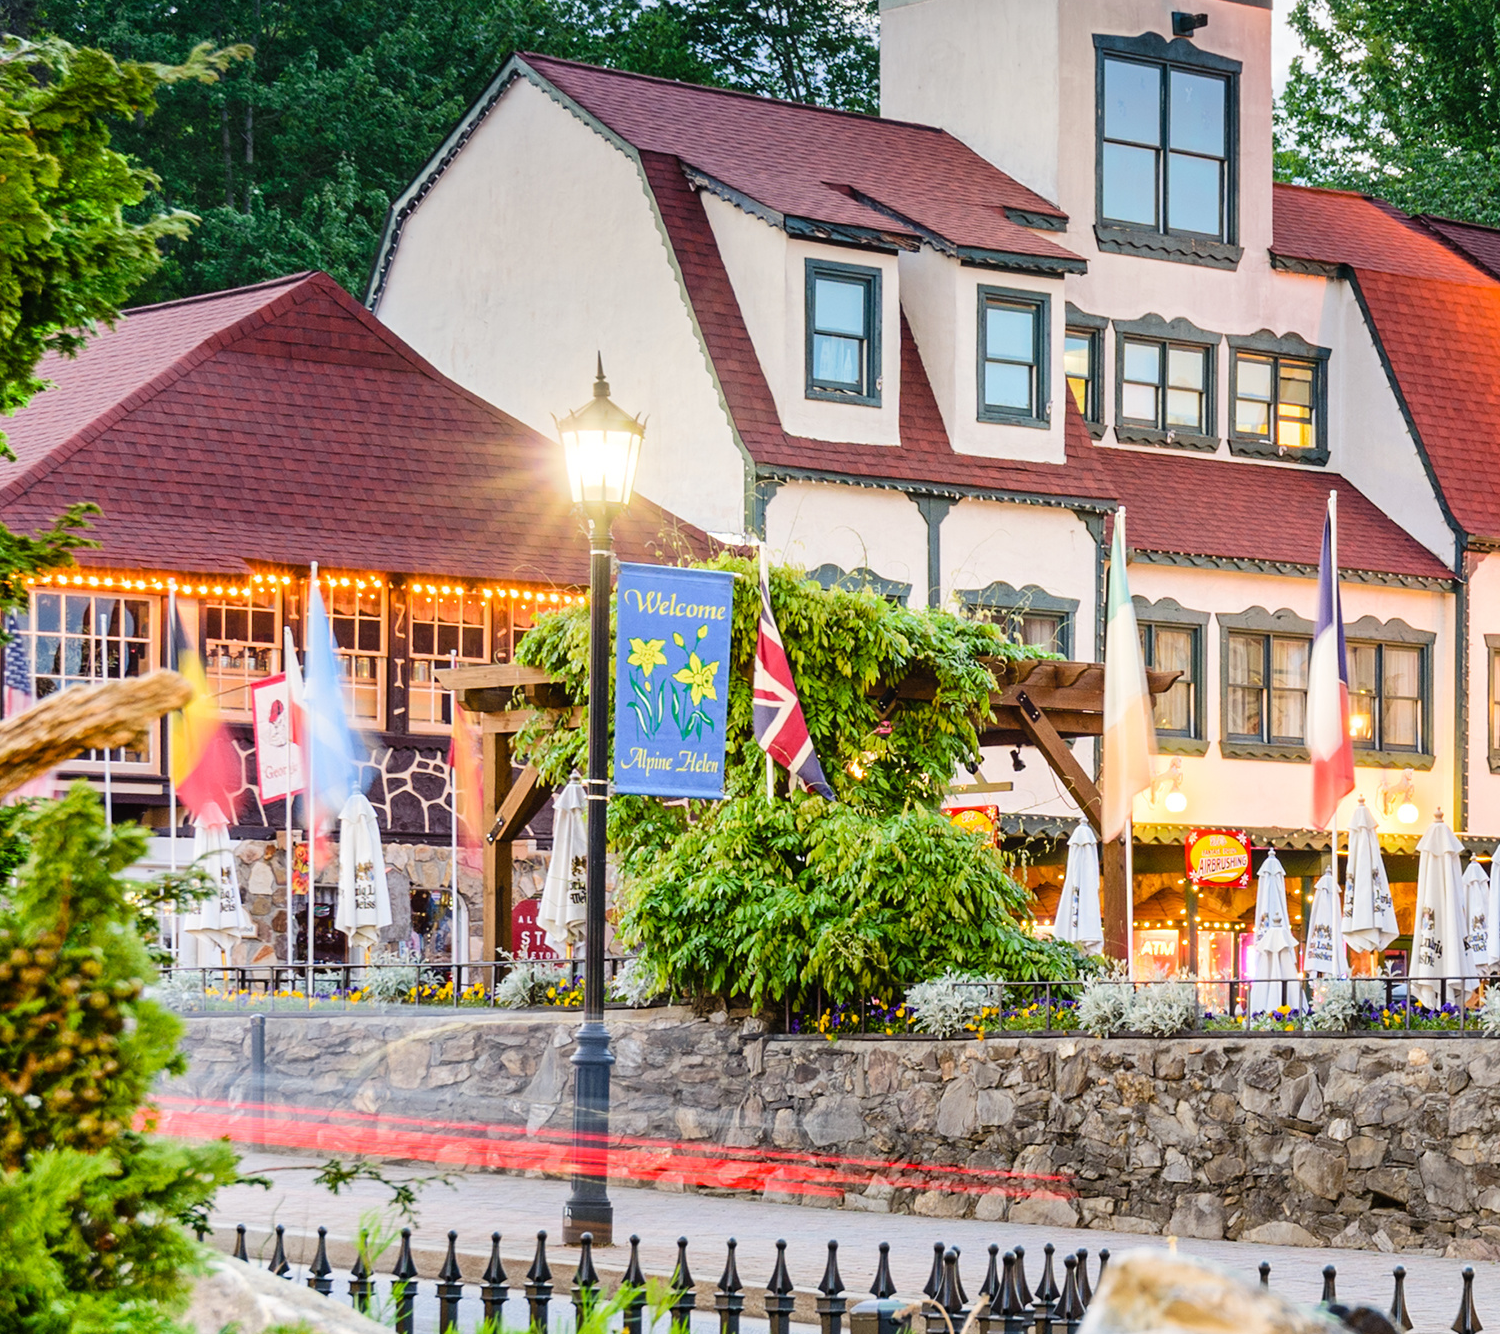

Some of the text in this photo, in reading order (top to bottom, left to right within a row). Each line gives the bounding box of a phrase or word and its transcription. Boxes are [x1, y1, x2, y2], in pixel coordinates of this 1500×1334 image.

[624, 589, 726, 620] Welcome
[621, 747, 719, 777] Alpine Helen
[1199, 856, 1247, 874] AIRBRUSHING
[1141, 941, 1175, 956] ATM
